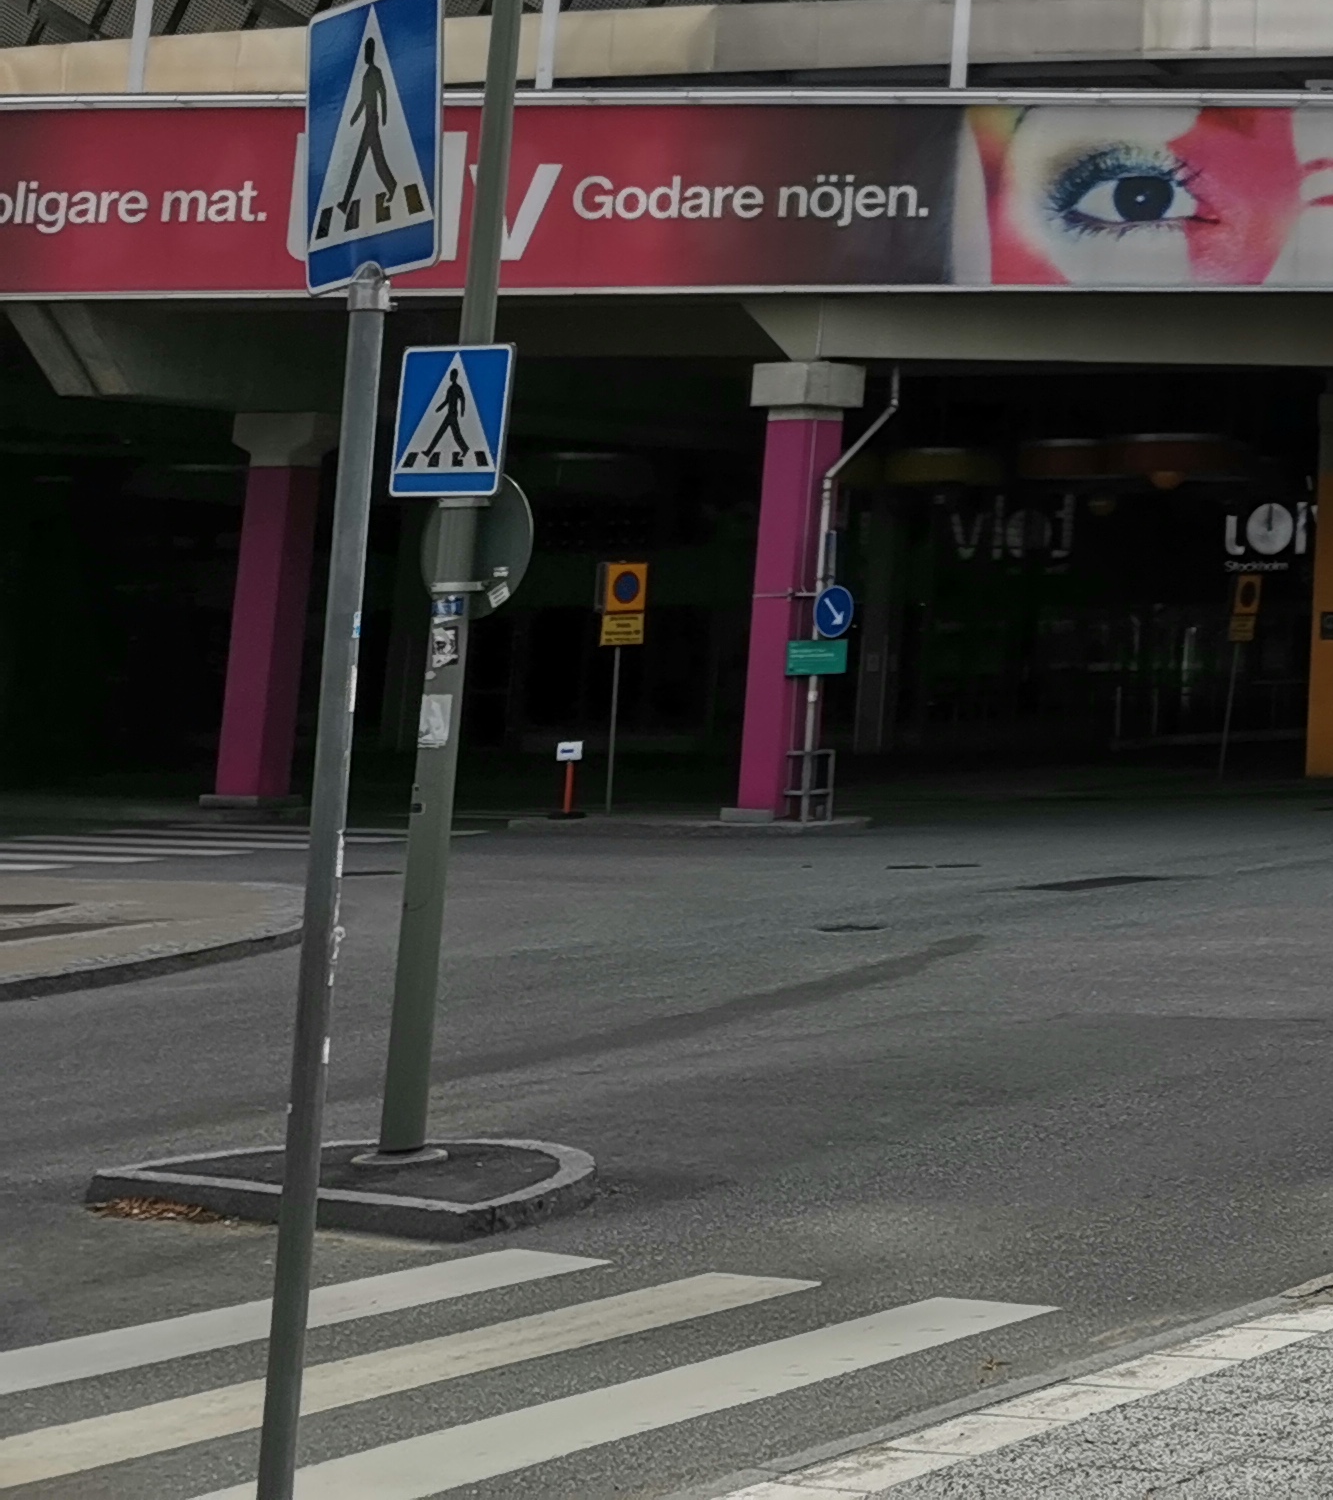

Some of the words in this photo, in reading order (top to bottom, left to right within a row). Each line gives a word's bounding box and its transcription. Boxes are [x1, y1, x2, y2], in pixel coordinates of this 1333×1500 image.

[160, 180, 267, 222] mat.
[573, 175, 764, 219] Godare
[777, 174, 930, 227] nöjen.
